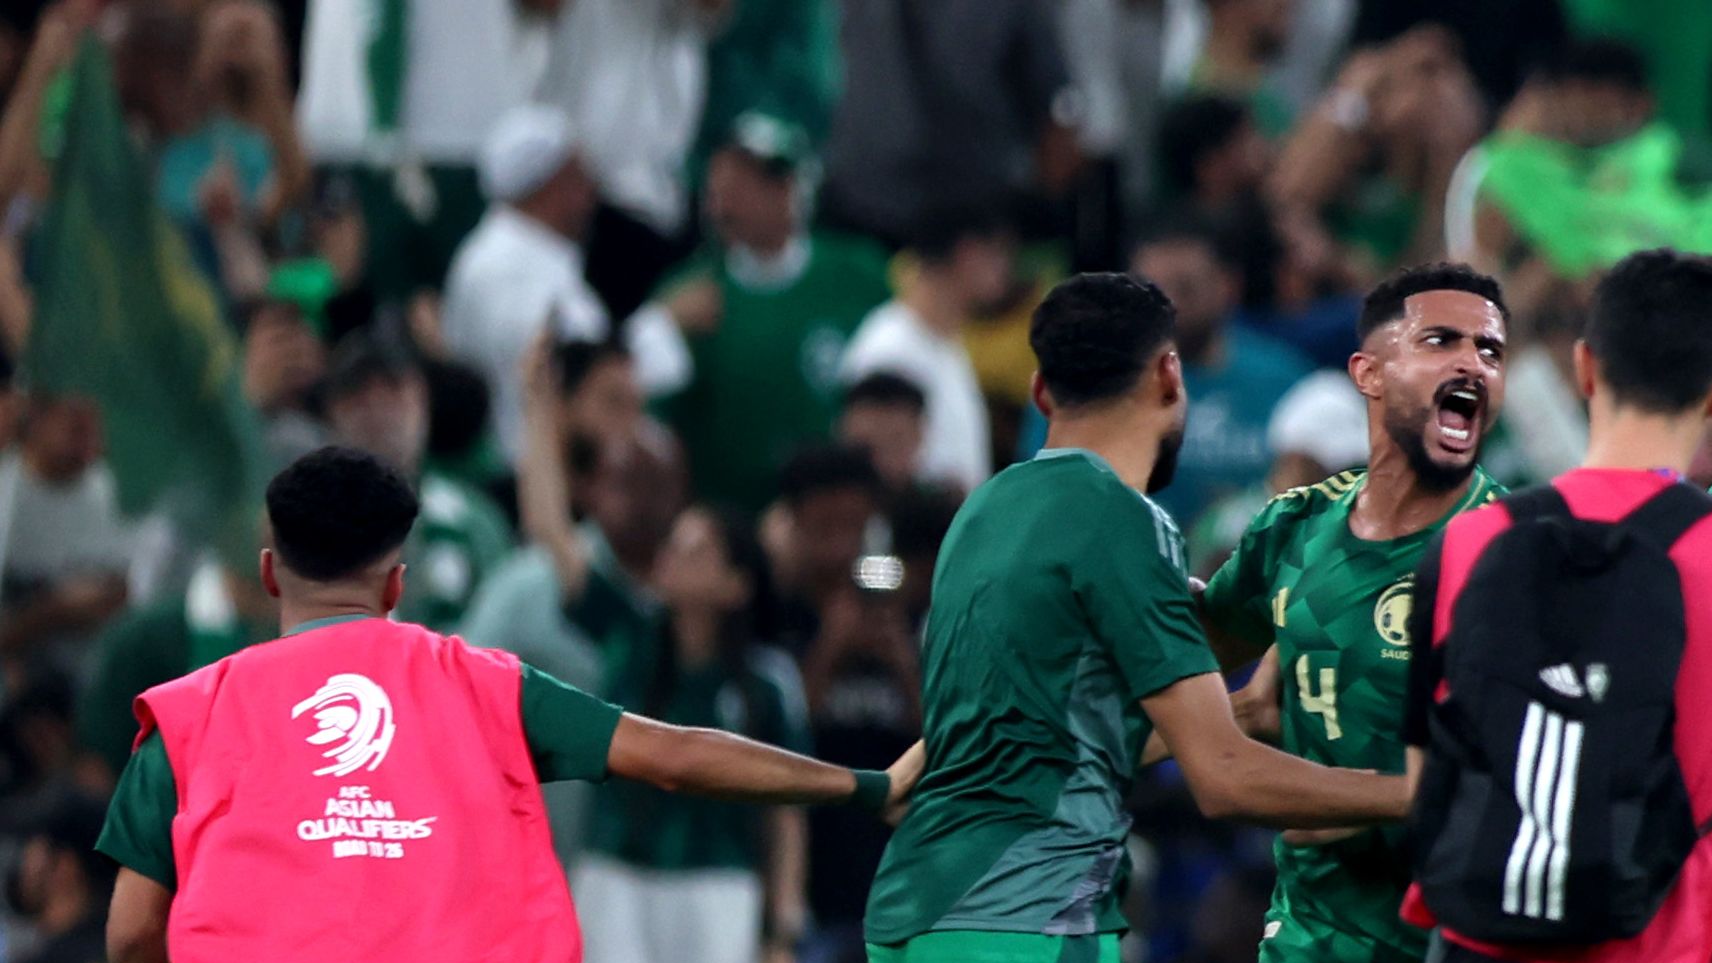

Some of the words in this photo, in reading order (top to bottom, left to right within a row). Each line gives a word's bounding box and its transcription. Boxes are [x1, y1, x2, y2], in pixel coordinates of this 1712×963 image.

[1380, 648, 1412, 661] SAUD
[1296, 653, 1343, 741] 4
[338, 785, 372, 799] AFC
[324, 798, 396, 819] ASIAN
[297, 815, 438, 841] QUALIFIERS
